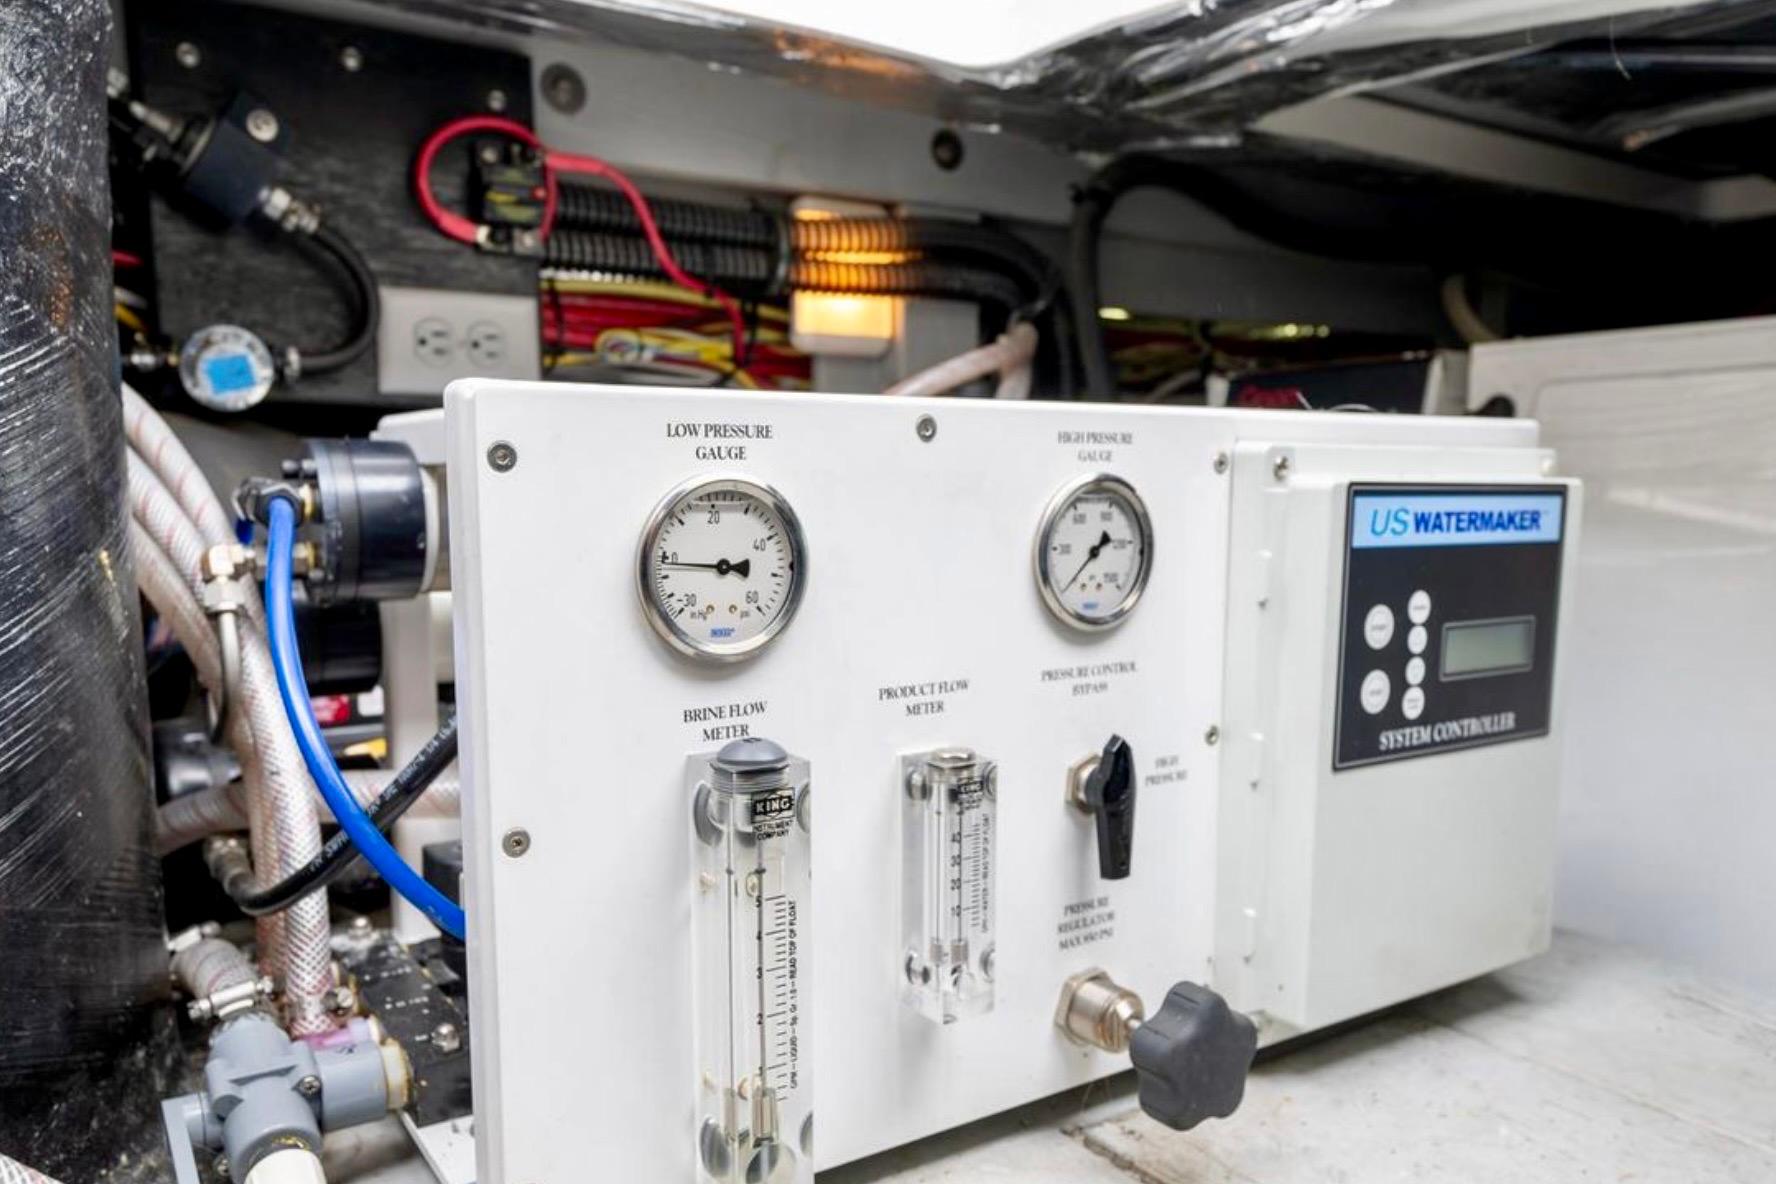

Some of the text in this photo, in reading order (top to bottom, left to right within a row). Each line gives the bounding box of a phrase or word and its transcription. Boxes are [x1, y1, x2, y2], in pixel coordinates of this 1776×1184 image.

[667, 423, 773, 439] LOW PRESSURE
[1057, 431, 1133, 445] HIGH PRESSURE
[695, 446, 747, 460] GAUGE
[1077, 449, 1112, 462] GAUGE
[707, 511, 720, 525] 20
[1370, 508, 1542, 536] US WATERMAKER
[753, 539, 766, 551] 40
[745, 590, 759, 604] 60
[1041, 661, 1136, 681] PRESSURE CONTROL
[879, 679, 970, 700] PRODUCT FLOW
[1071, 682, 1108, 696] BYPASS
[684, 701, 768, 723] BRINE FLOW
[905, 701, 945, 717] METER
[702, 724, 750, 742] METER
[1379, 711, 1516, 751] SYSTEM CONTROLLER
[755, 798, 791, 813] KING
[788, 901, 797, 926] FLOAT
[788, 928, 797, 939] OF
[788, 940, 797, 956] TOP
[788, 957, 797, 980] READ
